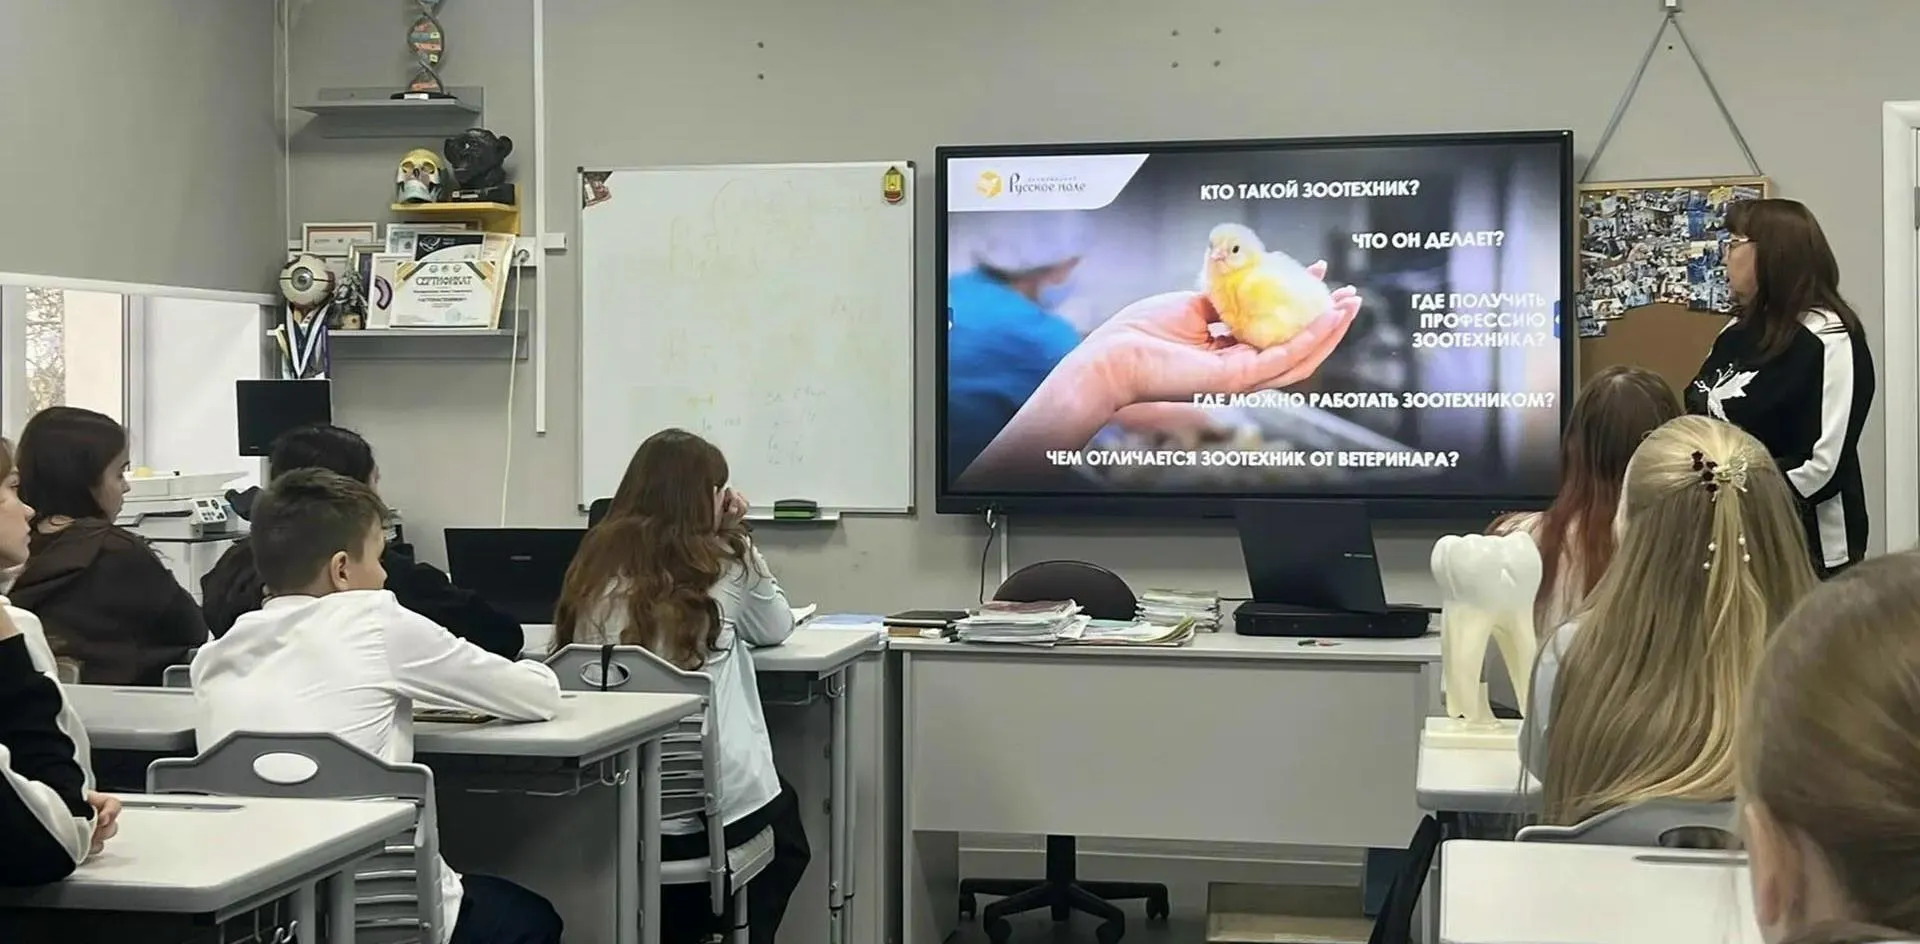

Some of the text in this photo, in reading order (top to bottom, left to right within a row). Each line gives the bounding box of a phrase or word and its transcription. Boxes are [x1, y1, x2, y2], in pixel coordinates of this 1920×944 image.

[1009, 172, 1055, 195] Русское
[1058, 183, 1087, 193] поле
[1200, 180, 1420, 200] КТО ТАКОЙ ЗООТЕХНИК?
[1352, 230, 1504, 249] ЧТО ОН ДЕЛАЕТ?
[1411, 293, 1546, 310] ГДЕ ПОЛУЧИТЬ
[1420, 312, 1546, 329] ПРОФЕССИЮ
[1412, 332, 1546, 349] ЗООТЕХНИКА?
[1193, 392, 1555, 409] ГДЕ МОЖНО РАБОТАТЬ ЗООТЕХНИКОМ?
[1046, 450, 1460, 468] ЧЕМ ОТЛИЧАЕТСЯ ЗООТЕХНИК ОТ ВЕТЕРИНАРА?
